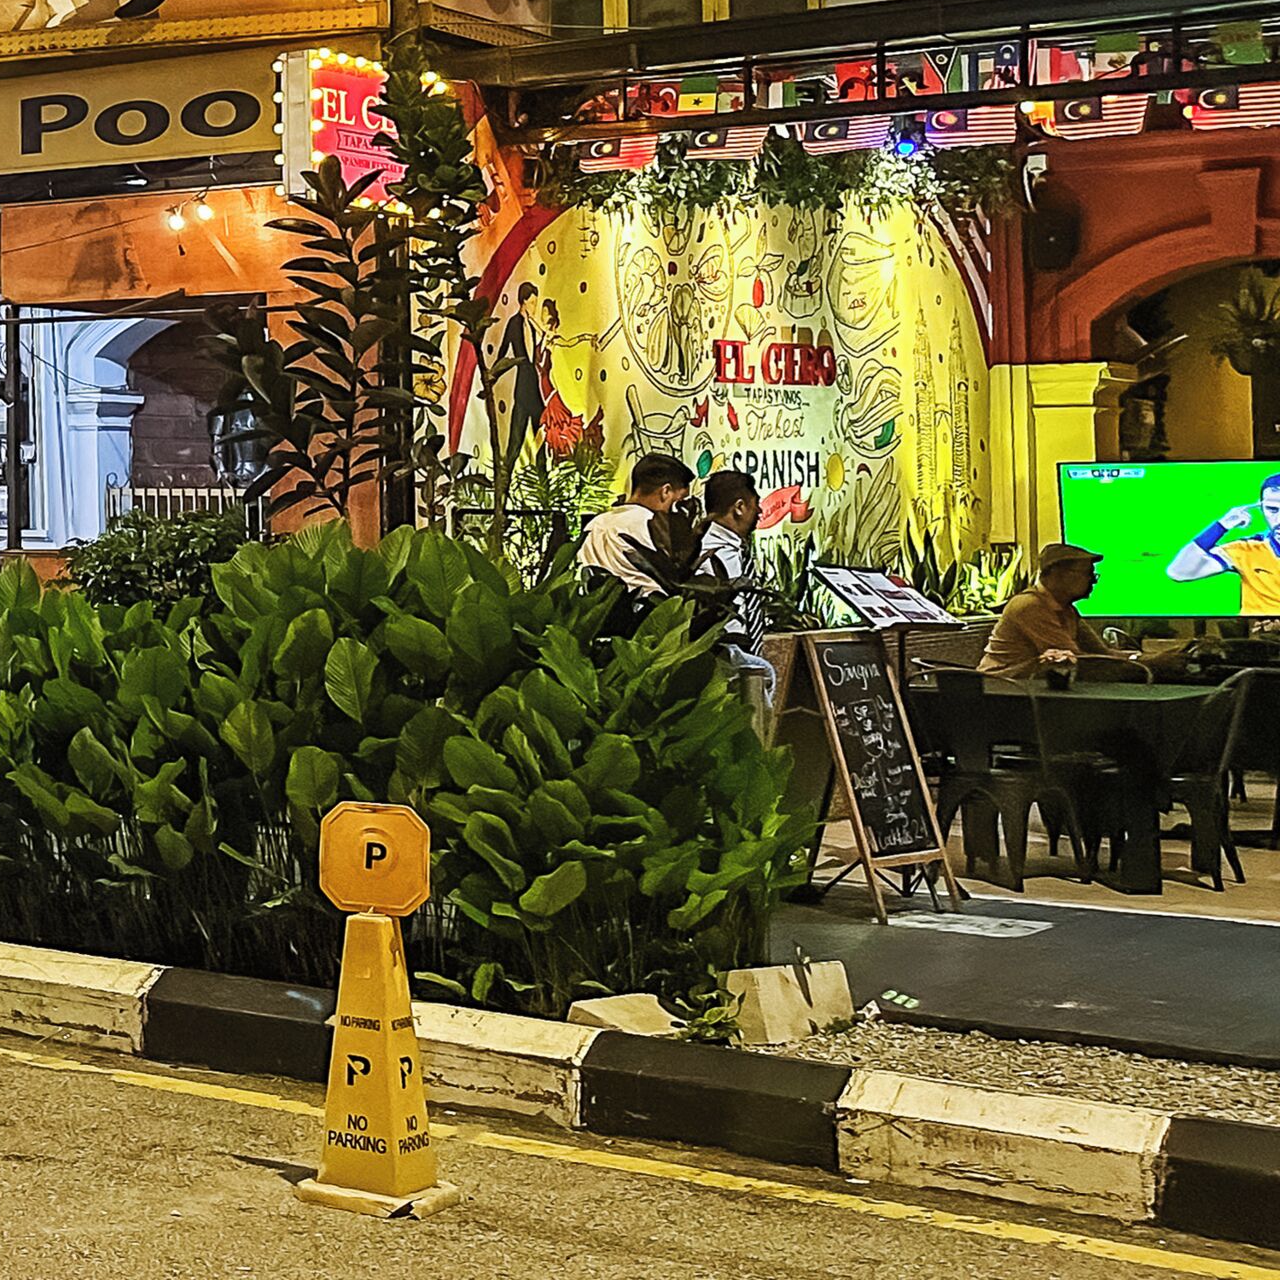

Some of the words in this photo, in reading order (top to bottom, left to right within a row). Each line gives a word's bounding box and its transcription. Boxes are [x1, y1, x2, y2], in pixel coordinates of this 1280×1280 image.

[321, 87, 356, 126] EL
[713, 339, 755, 385] EL
[761, 342, 837, 387] CERO
[745, 410, 773, 441] The
[776, 409, 806, 439] best
[732, 450, 820, 489] SPANISH
[364, 842, 387, 870] P
[347, 1114, 369, 1132] NO
[327, 1129, 388, 1155] PARKING
[397, 1131, 431, 1156] PARKING
